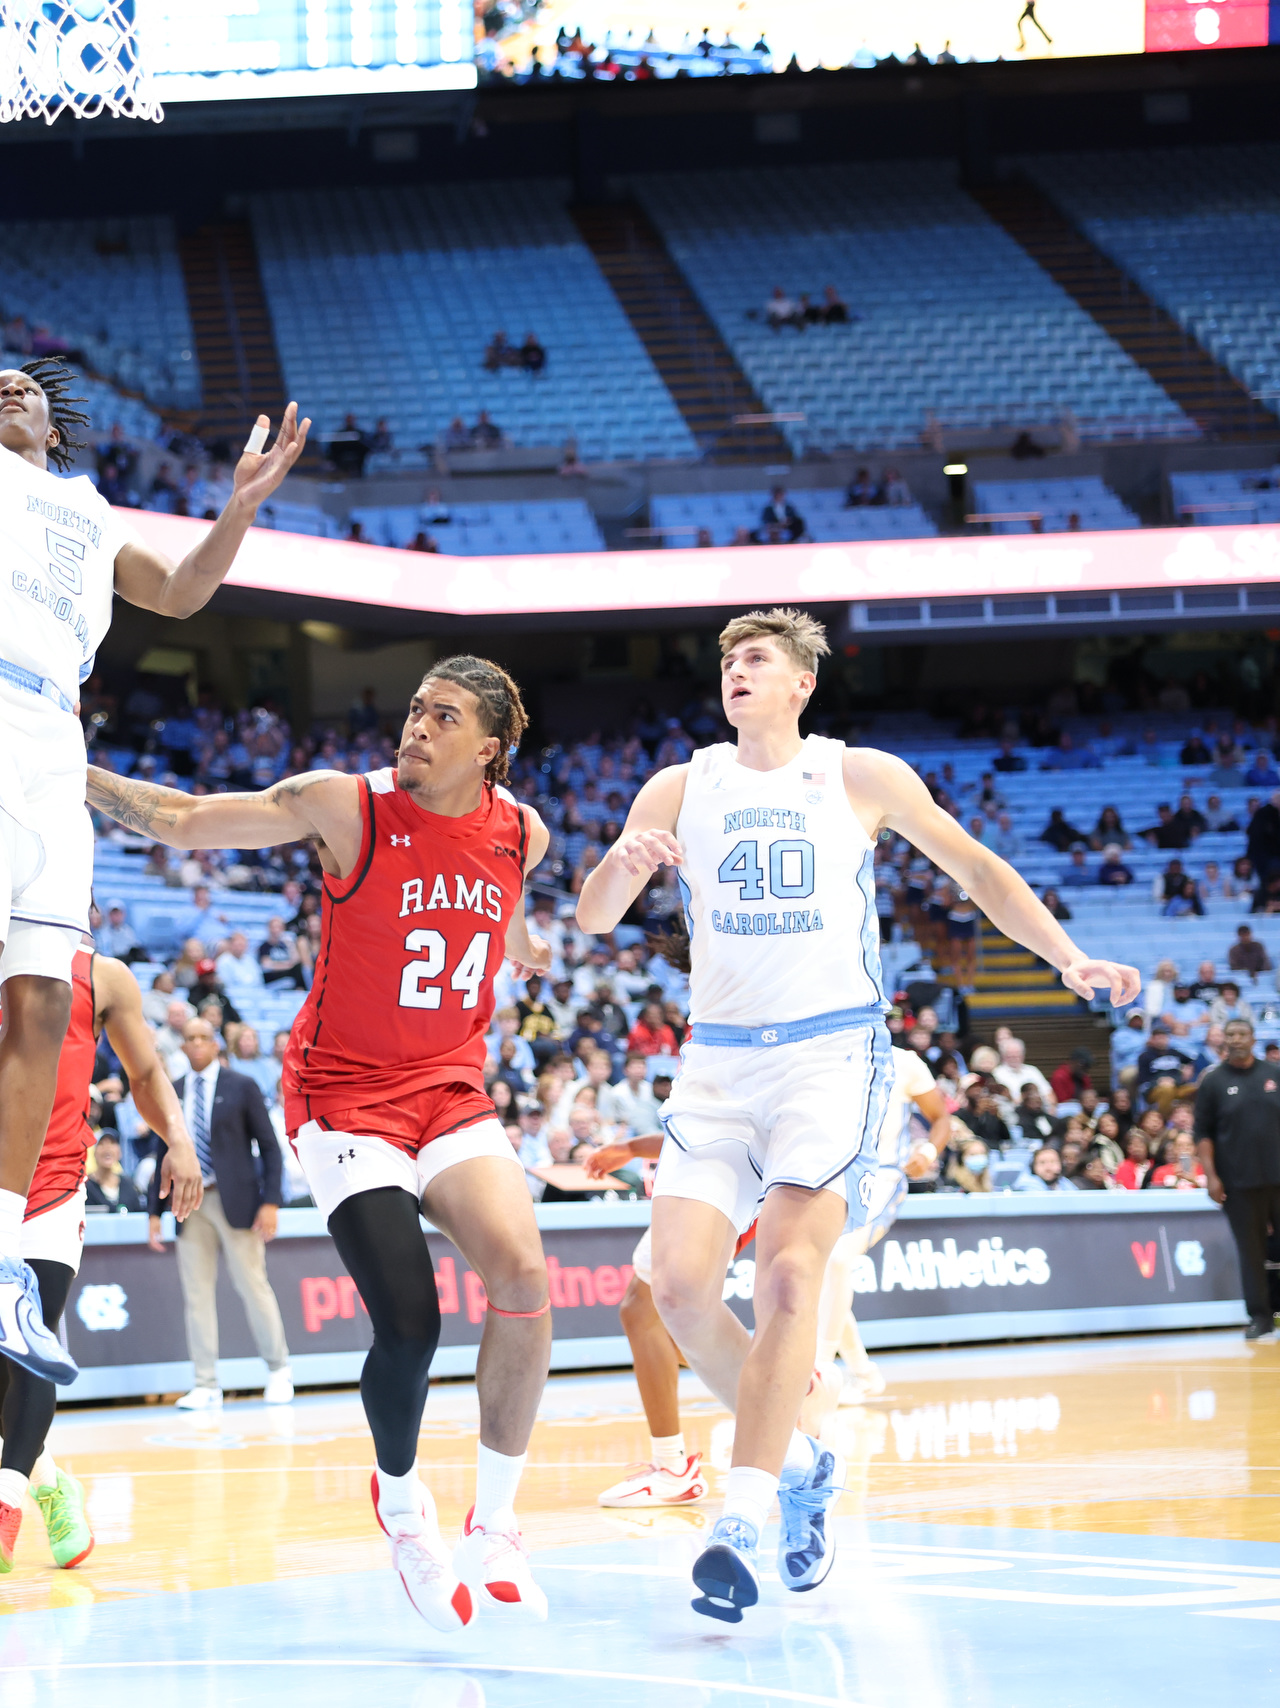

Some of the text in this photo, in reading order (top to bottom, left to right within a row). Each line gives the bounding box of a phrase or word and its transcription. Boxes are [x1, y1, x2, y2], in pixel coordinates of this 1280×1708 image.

[26, 495, 102, 549] NORTH
[46, 528, 85, 595] 5
[724, 808, 807, 834] NORTH
[718, 839, 815, 900] 40
[398, 873, 502, 923] RAMS
[712, 909, 823, 935] CAROLINA
[398, 928, 491, 1010] 24
[880, 1237, 1052, 1293] Athletics
